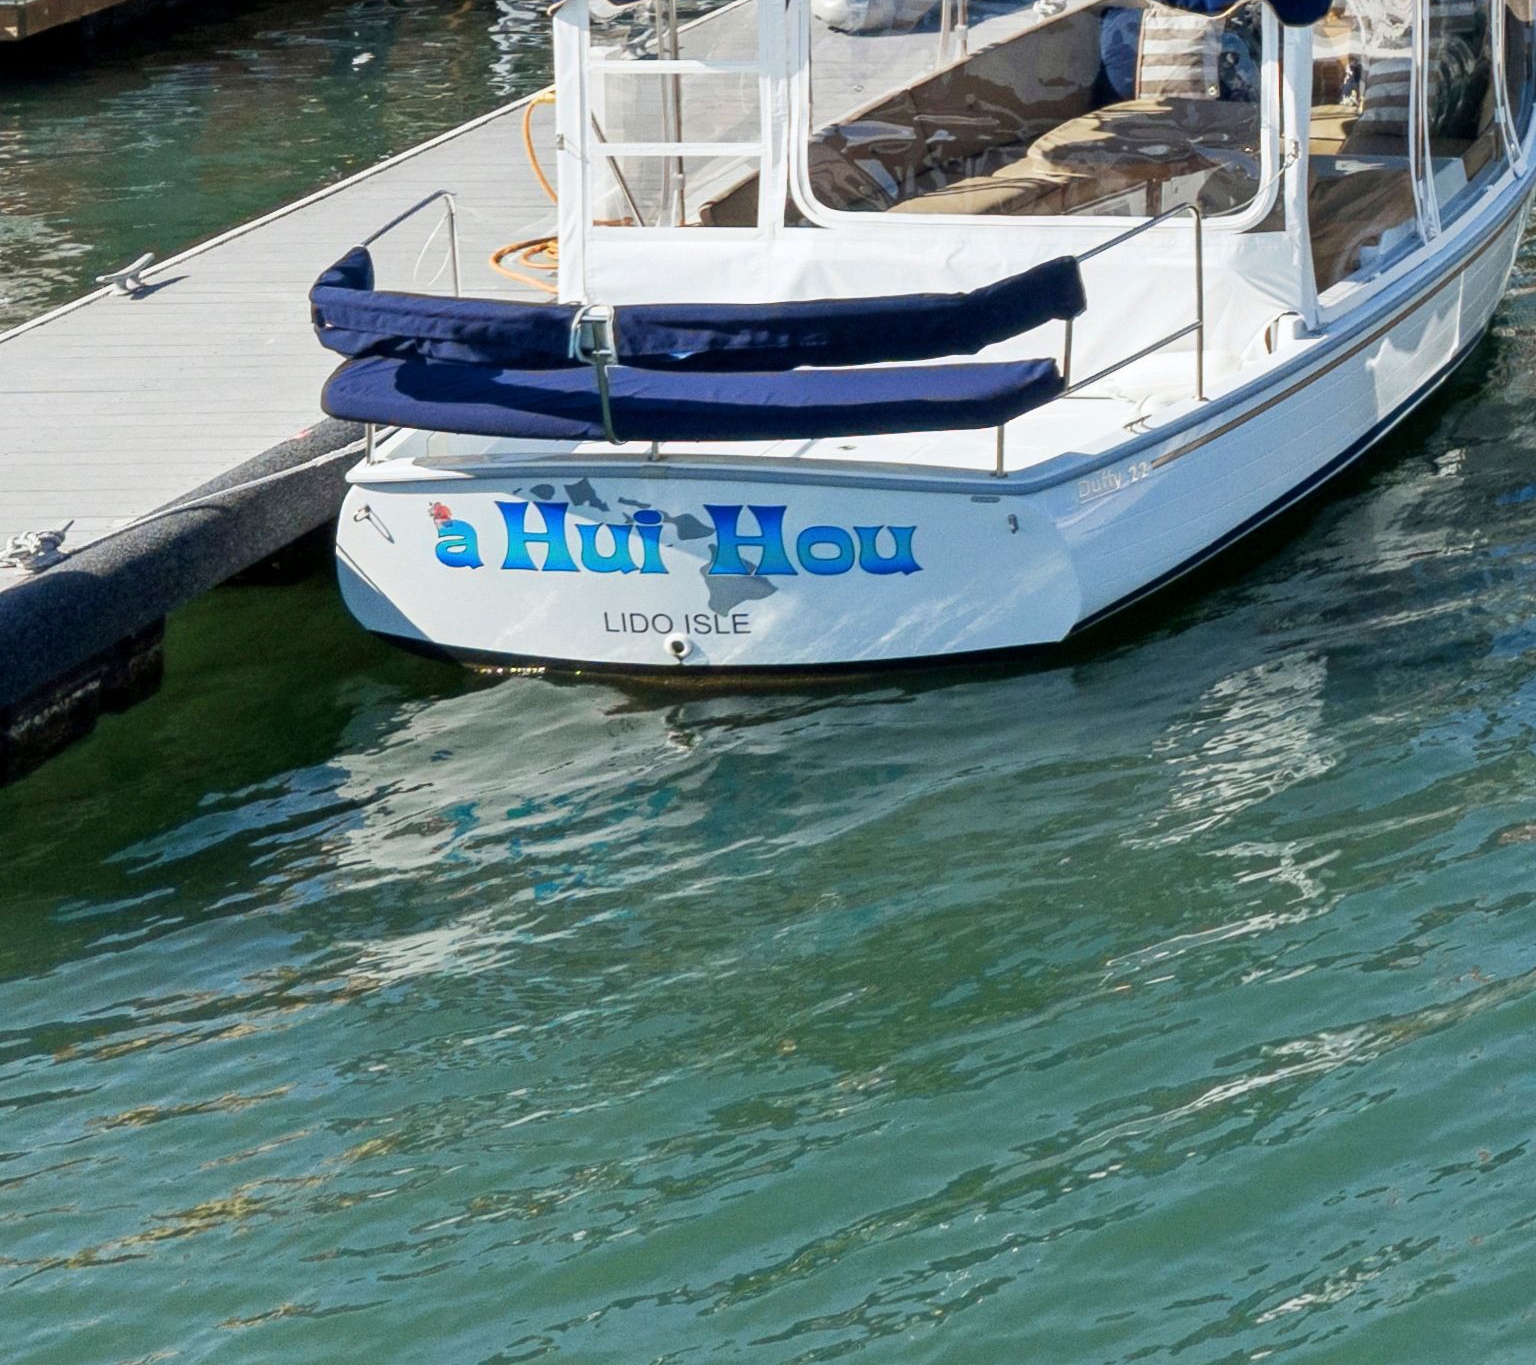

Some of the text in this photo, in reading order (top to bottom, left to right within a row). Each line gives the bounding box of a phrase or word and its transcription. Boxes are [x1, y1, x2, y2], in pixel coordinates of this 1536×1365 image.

[1079, 461, 1149, 498] Duffy 22
[435, 500, 924, 576] a Hui Hou
[603, 611, 752, 636] LIDO ISLE
